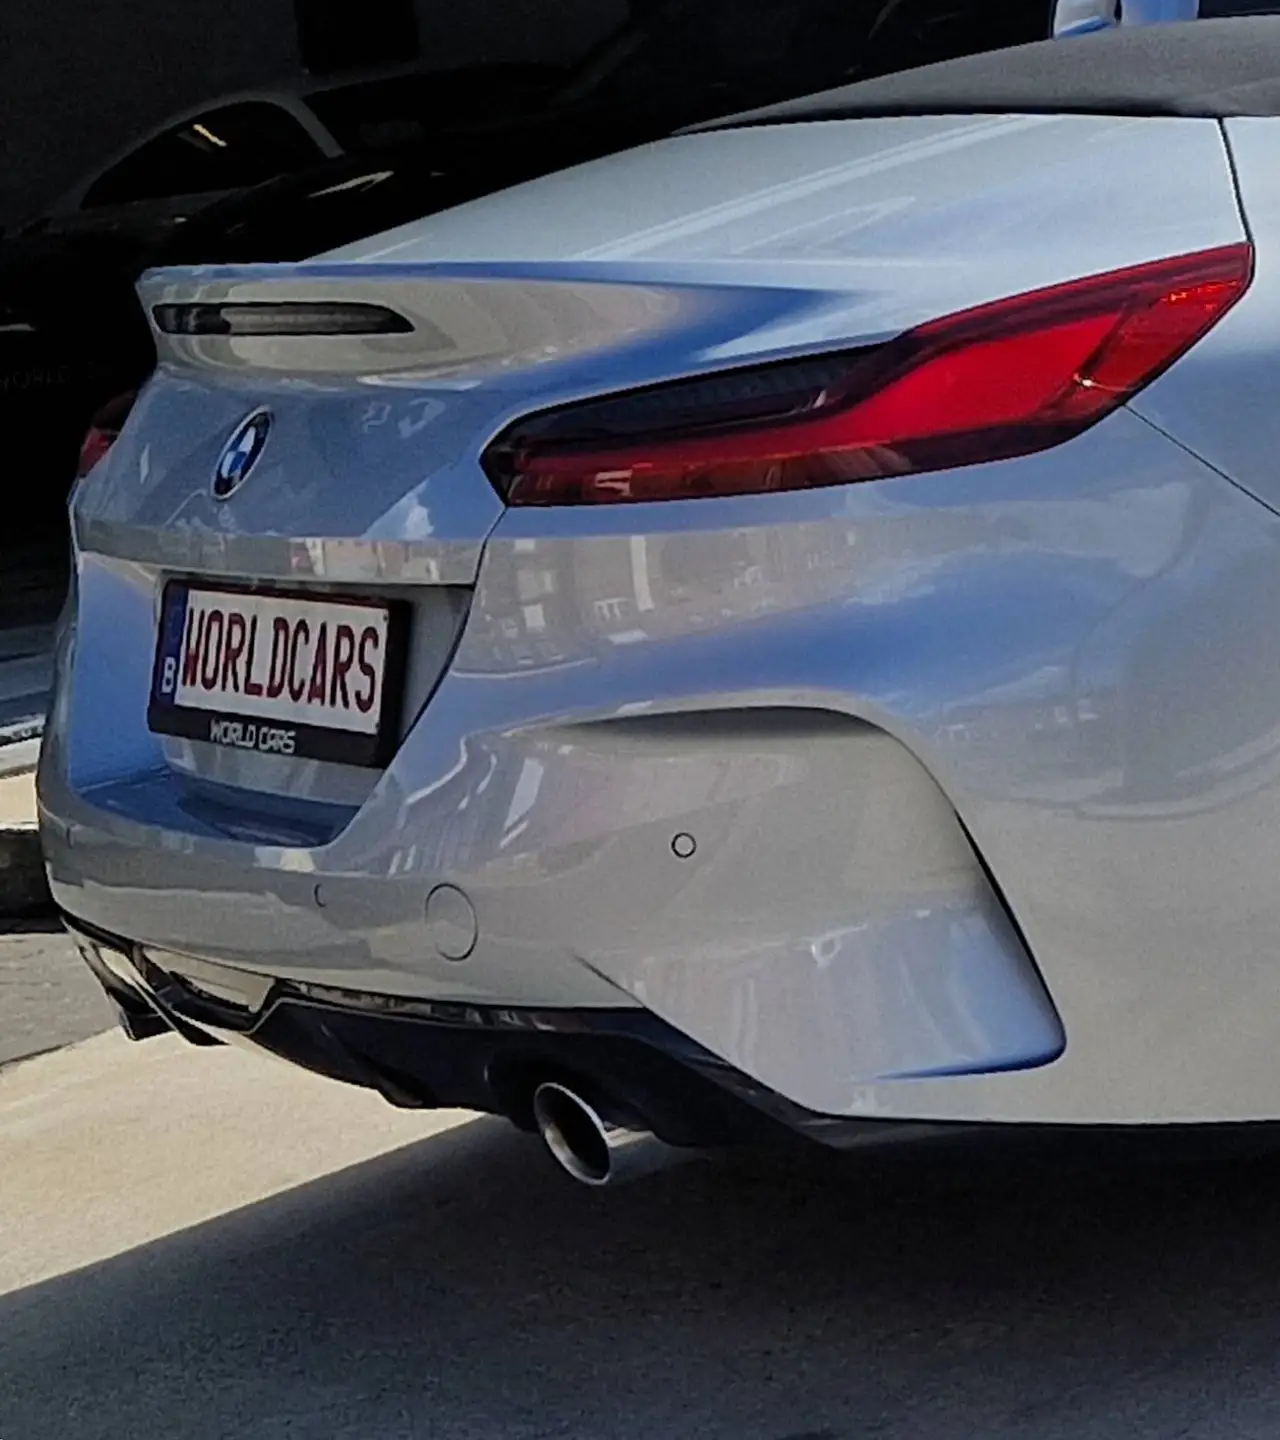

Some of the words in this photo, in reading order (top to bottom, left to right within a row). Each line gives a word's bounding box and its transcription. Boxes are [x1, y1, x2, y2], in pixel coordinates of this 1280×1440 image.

[161, 656, 177, 694] B
[181, 606, 380, 714] WORLDCARS
[210, 718, 257, 748] WORLD
[258, 726, 297, 754] CARS
